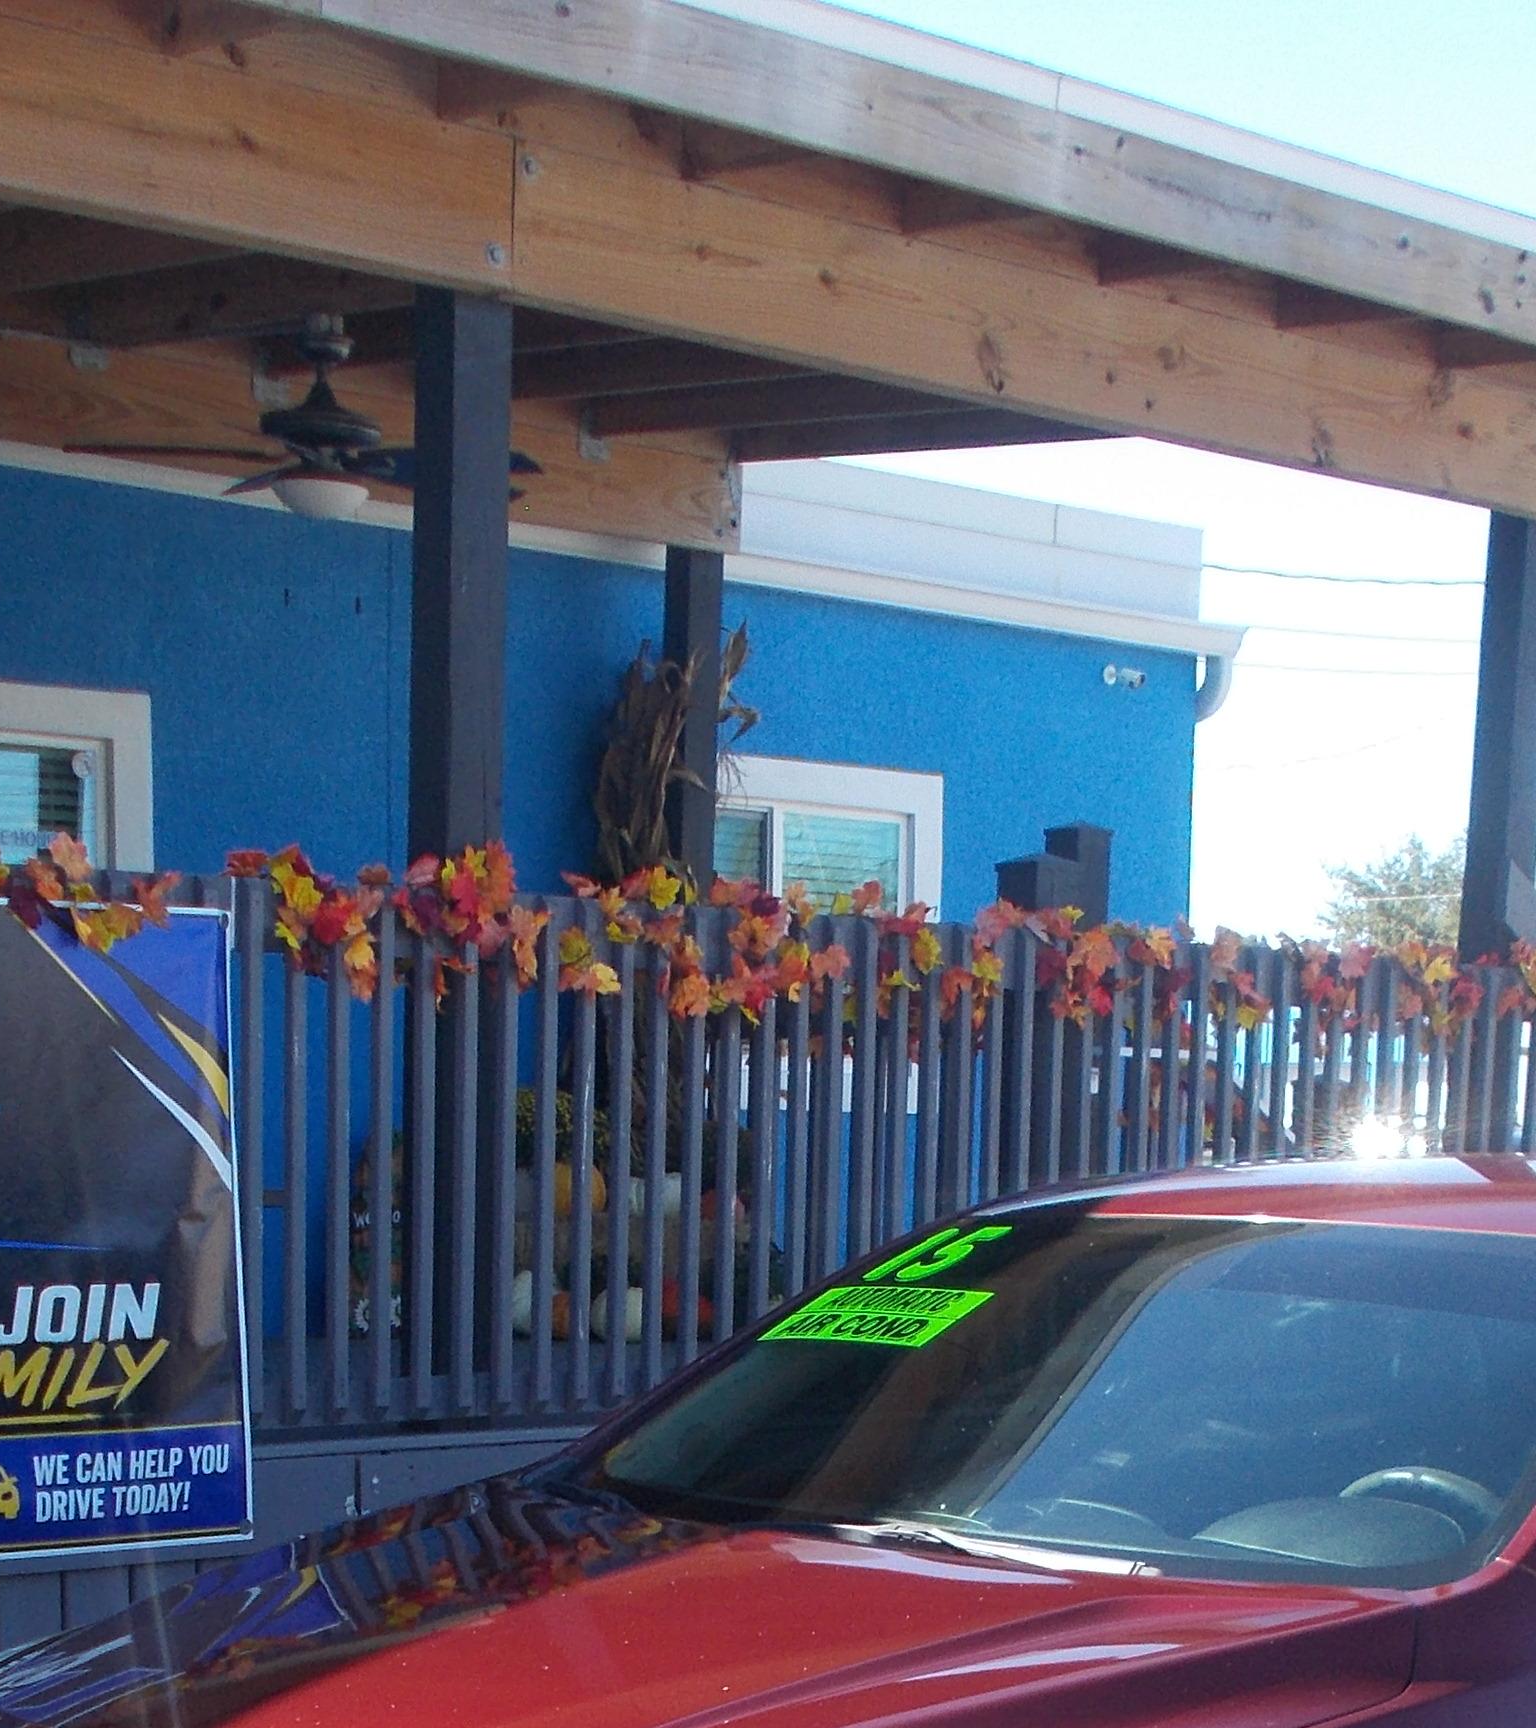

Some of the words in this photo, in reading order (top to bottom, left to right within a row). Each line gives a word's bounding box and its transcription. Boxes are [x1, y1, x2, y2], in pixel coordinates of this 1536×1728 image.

[862, 1226, 1013, 1282] 15
[826, 1288, 966, 1313] AUTOMATIC
[782, 1313, 833, 1336] AIR
[33, 1453, 70, 1487] WE
[76, 1451, 123, 1484] CAN
[129, 1447, 183, 1480] HELP
[188, 1443, 230, 1476] YOU
[35, 1487, 105, 1523] DRIVE
[112, 1481, 191, 1518] TODAY!
